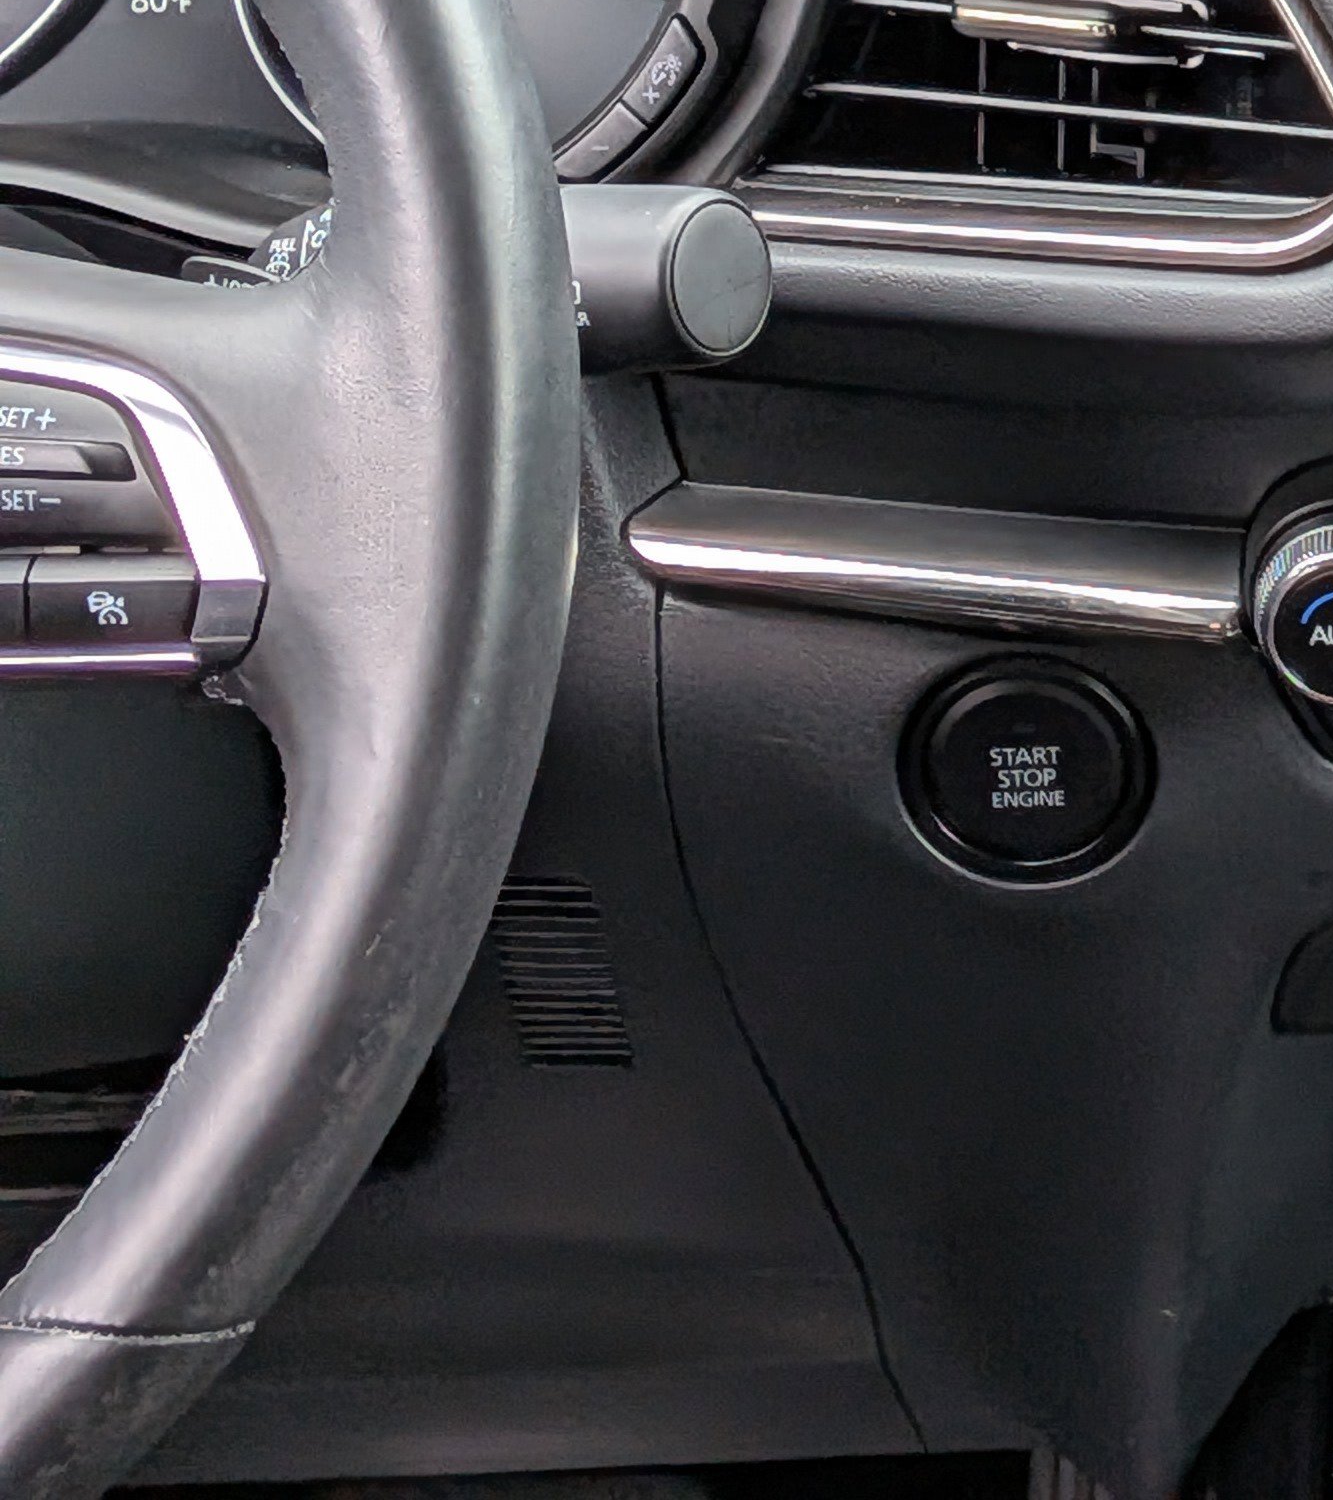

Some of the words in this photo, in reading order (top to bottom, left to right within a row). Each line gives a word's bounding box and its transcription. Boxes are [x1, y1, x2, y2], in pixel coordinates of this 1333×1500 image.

[0, 446, 26, 466] ES
[989, 746, 1061, 767] START
[997, 769, 1057, 789] STOP
[991, 790, 1066, 809] ENGINE
